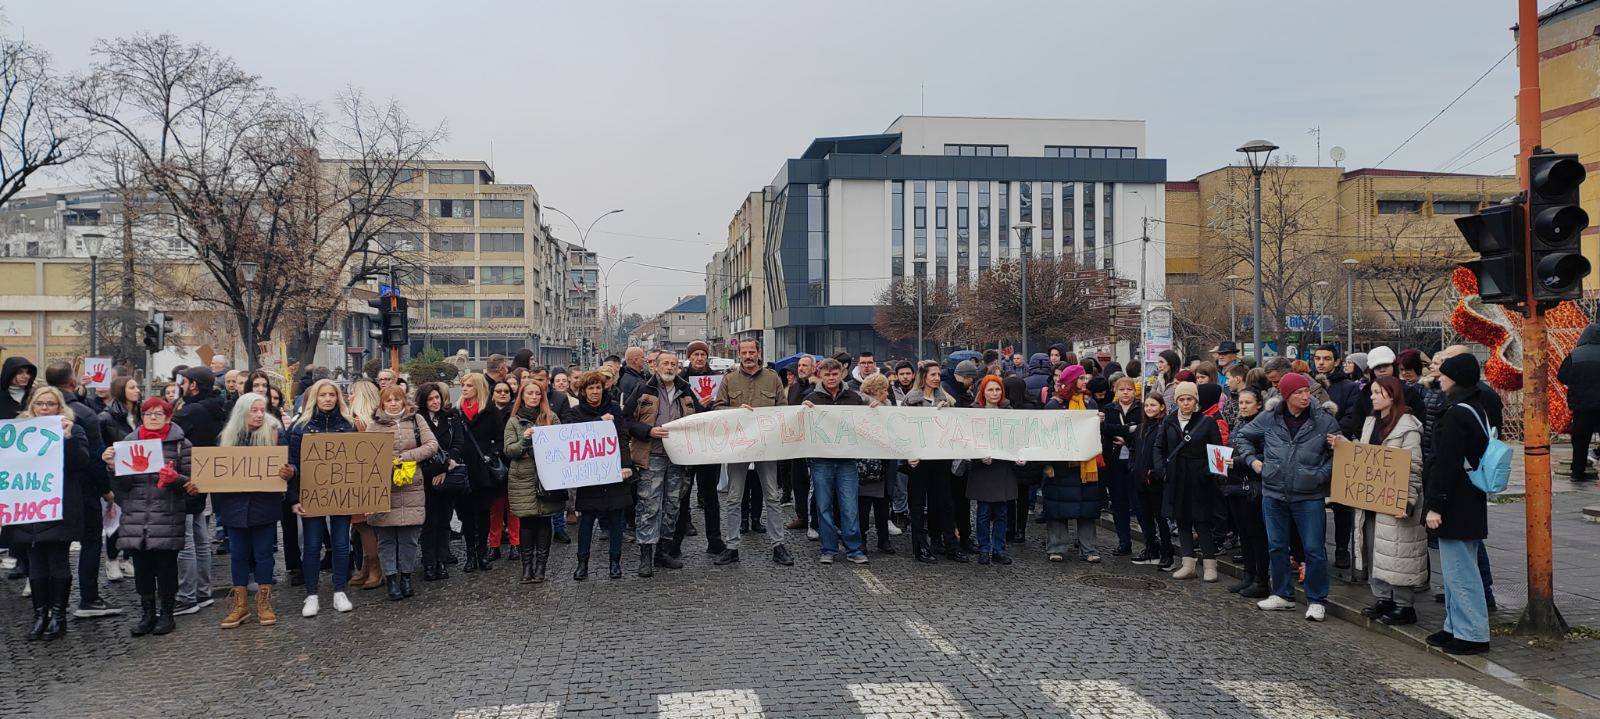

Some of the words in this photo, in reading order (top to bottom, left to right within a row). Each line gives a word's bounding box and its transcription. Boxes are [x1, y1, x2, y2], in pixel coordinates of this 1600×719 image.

[682, 408, 859, 455] ПОДРШКА
[886, 411, 1079, 452] СТУДЕНТИМА
[304, 441, 347, 462] ДВА
[355, 440, 385, 464] СУ
[569, 436, 617, 462] НАШУ
[1354, 445, 1393, 468] РУКЕ
[194, 455, 280, 481] УБИЦЕ
[313, 462, 383, 486] СВЕТА
[1344, 463, 1360, 479] СУ
[1365, 466, 1397, 484] ВАМ
[301, 486, 391, 509] РАЗЛИЧИТА
[1345, 480, 1408, 509] КРВАВЕ
